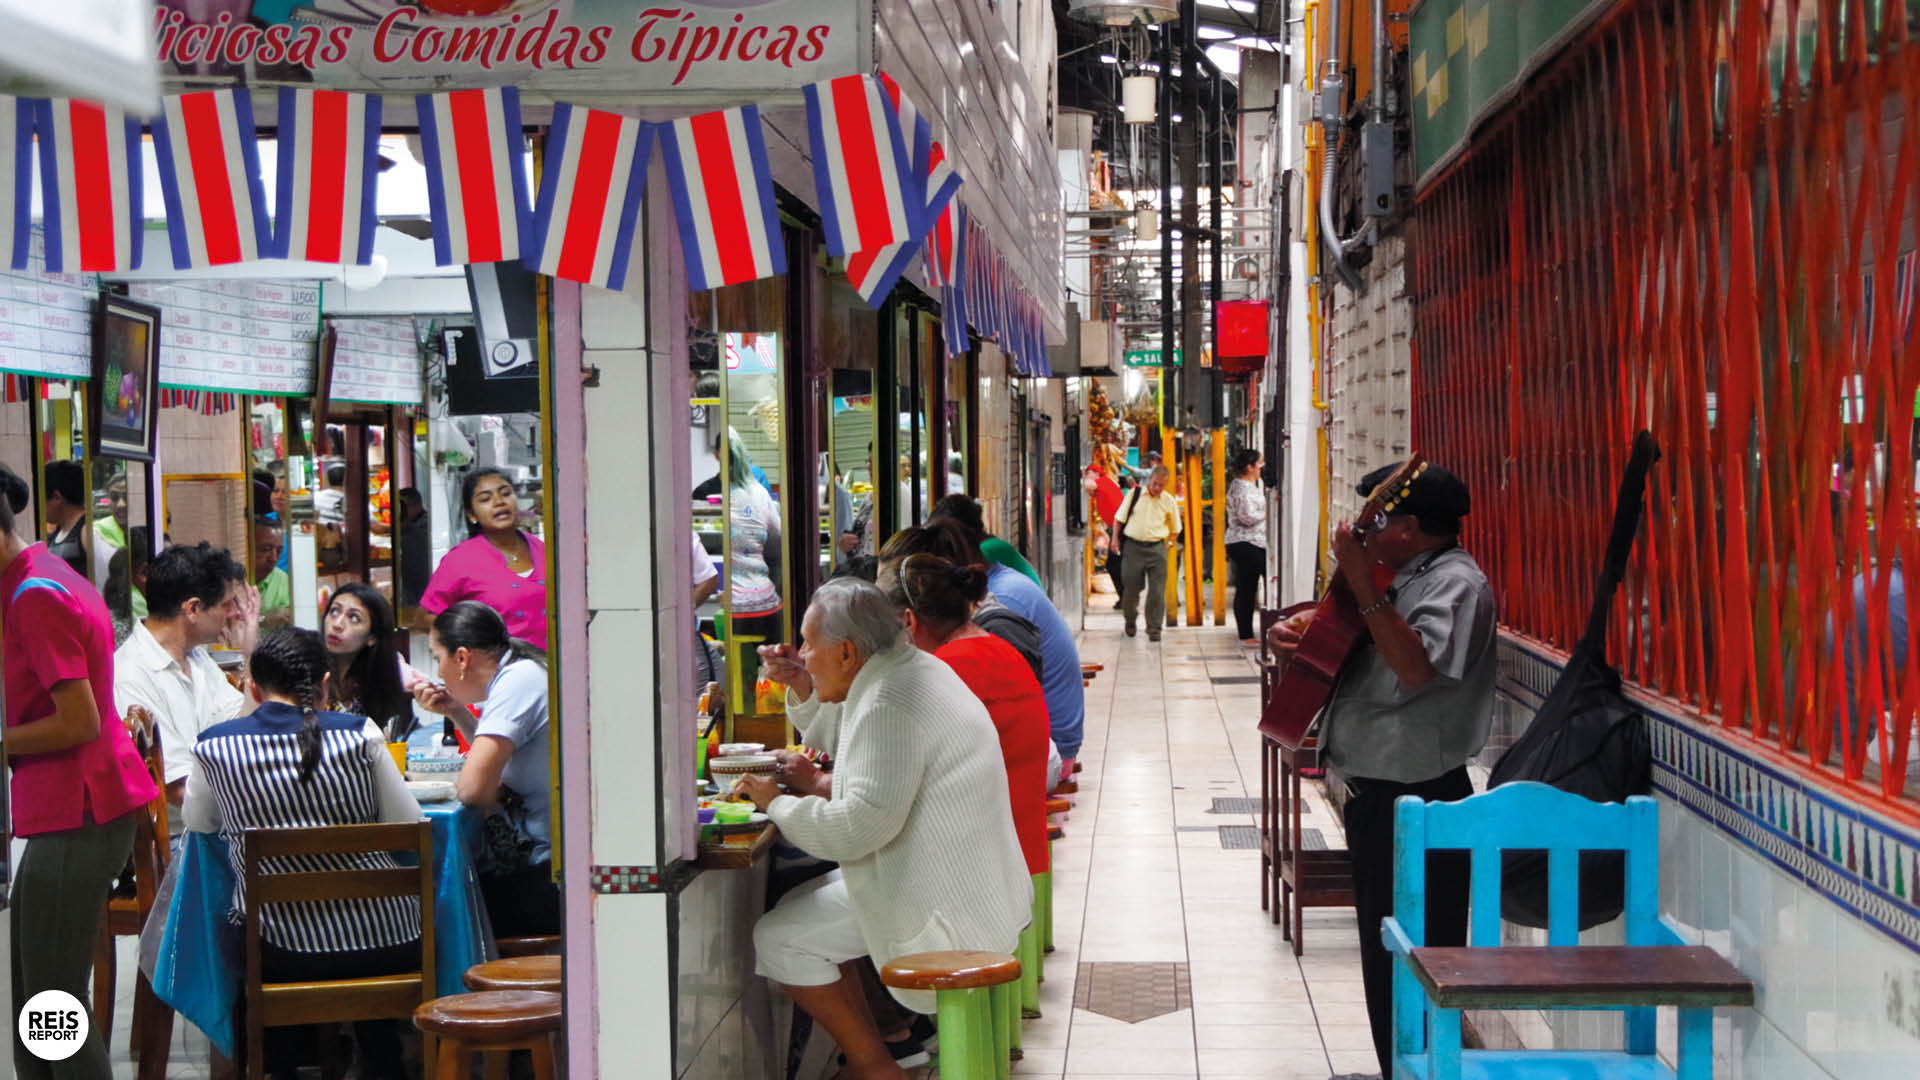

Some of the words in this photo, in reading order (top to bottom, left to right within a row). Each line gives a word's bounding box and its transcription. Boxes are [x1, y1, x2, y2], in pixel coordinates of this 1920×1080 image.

[373, 7, 613, 70] Comidas
[631, 8, 831, 86] Típicas
[1144, 352, 1179, 364] SALA
